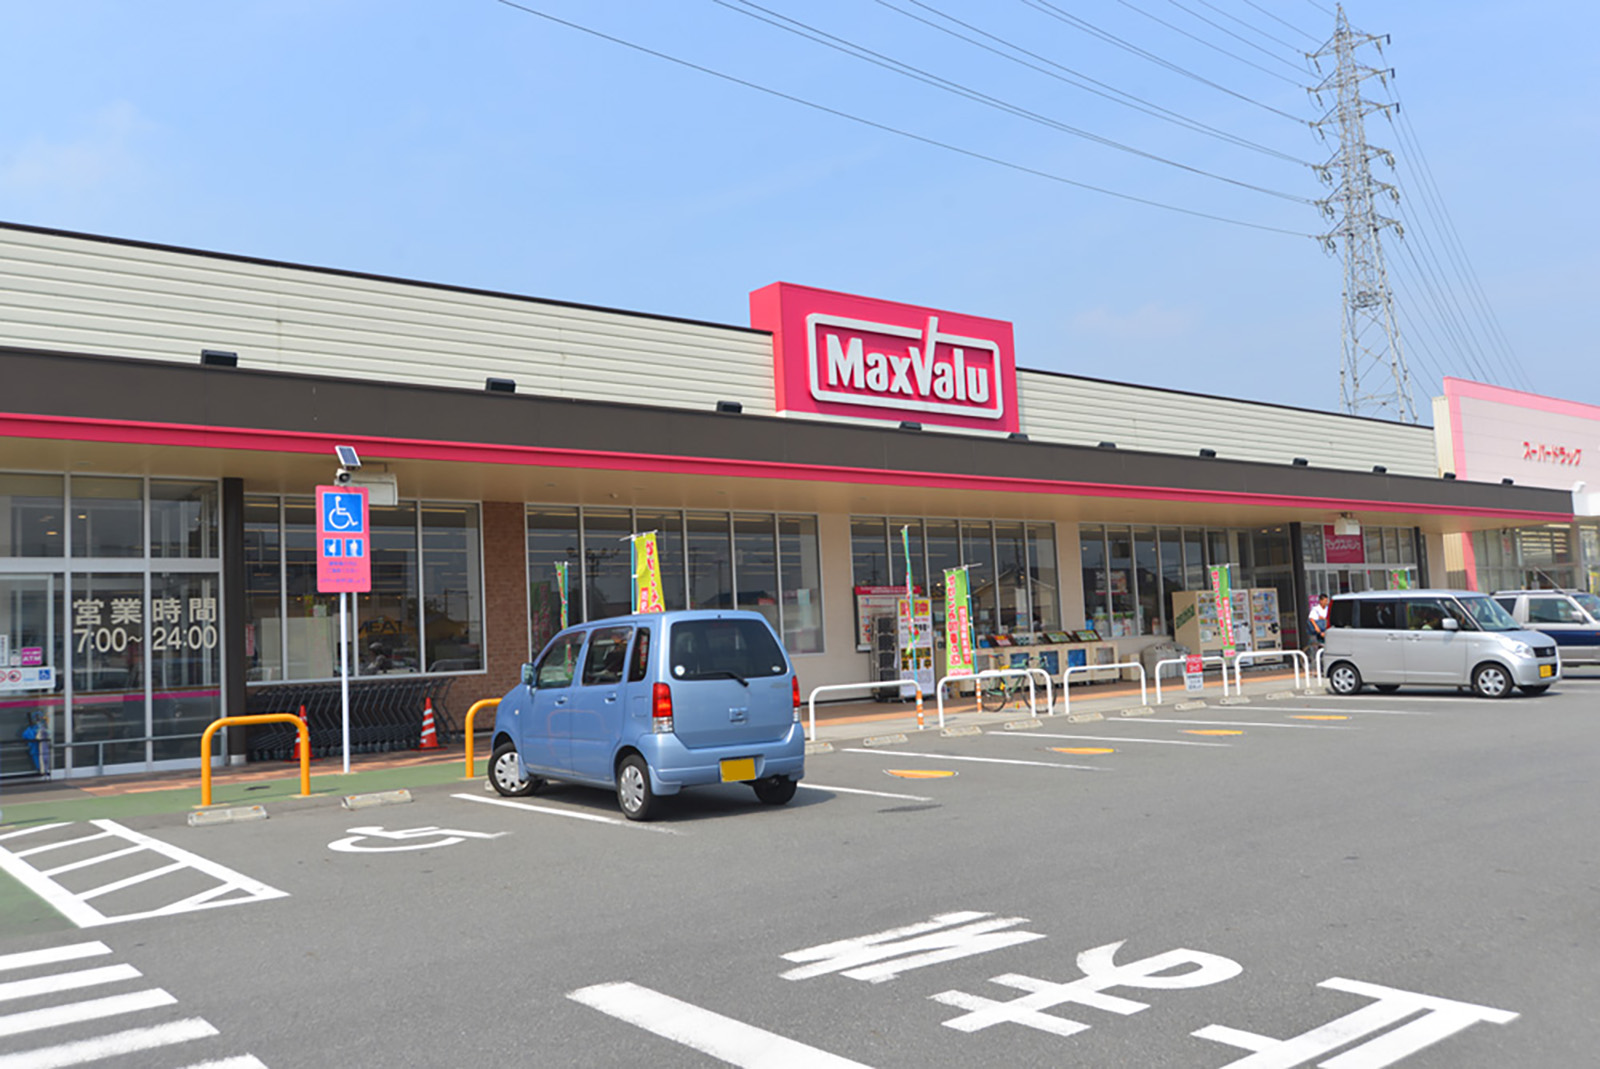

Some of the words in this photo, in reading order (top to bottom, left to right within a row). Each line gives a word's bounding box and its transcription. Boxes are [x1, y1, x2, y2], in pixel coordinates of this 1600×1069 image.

[826, 317, 989, 403] MaxValu
[73, 598, 216, 625] 営業時間
